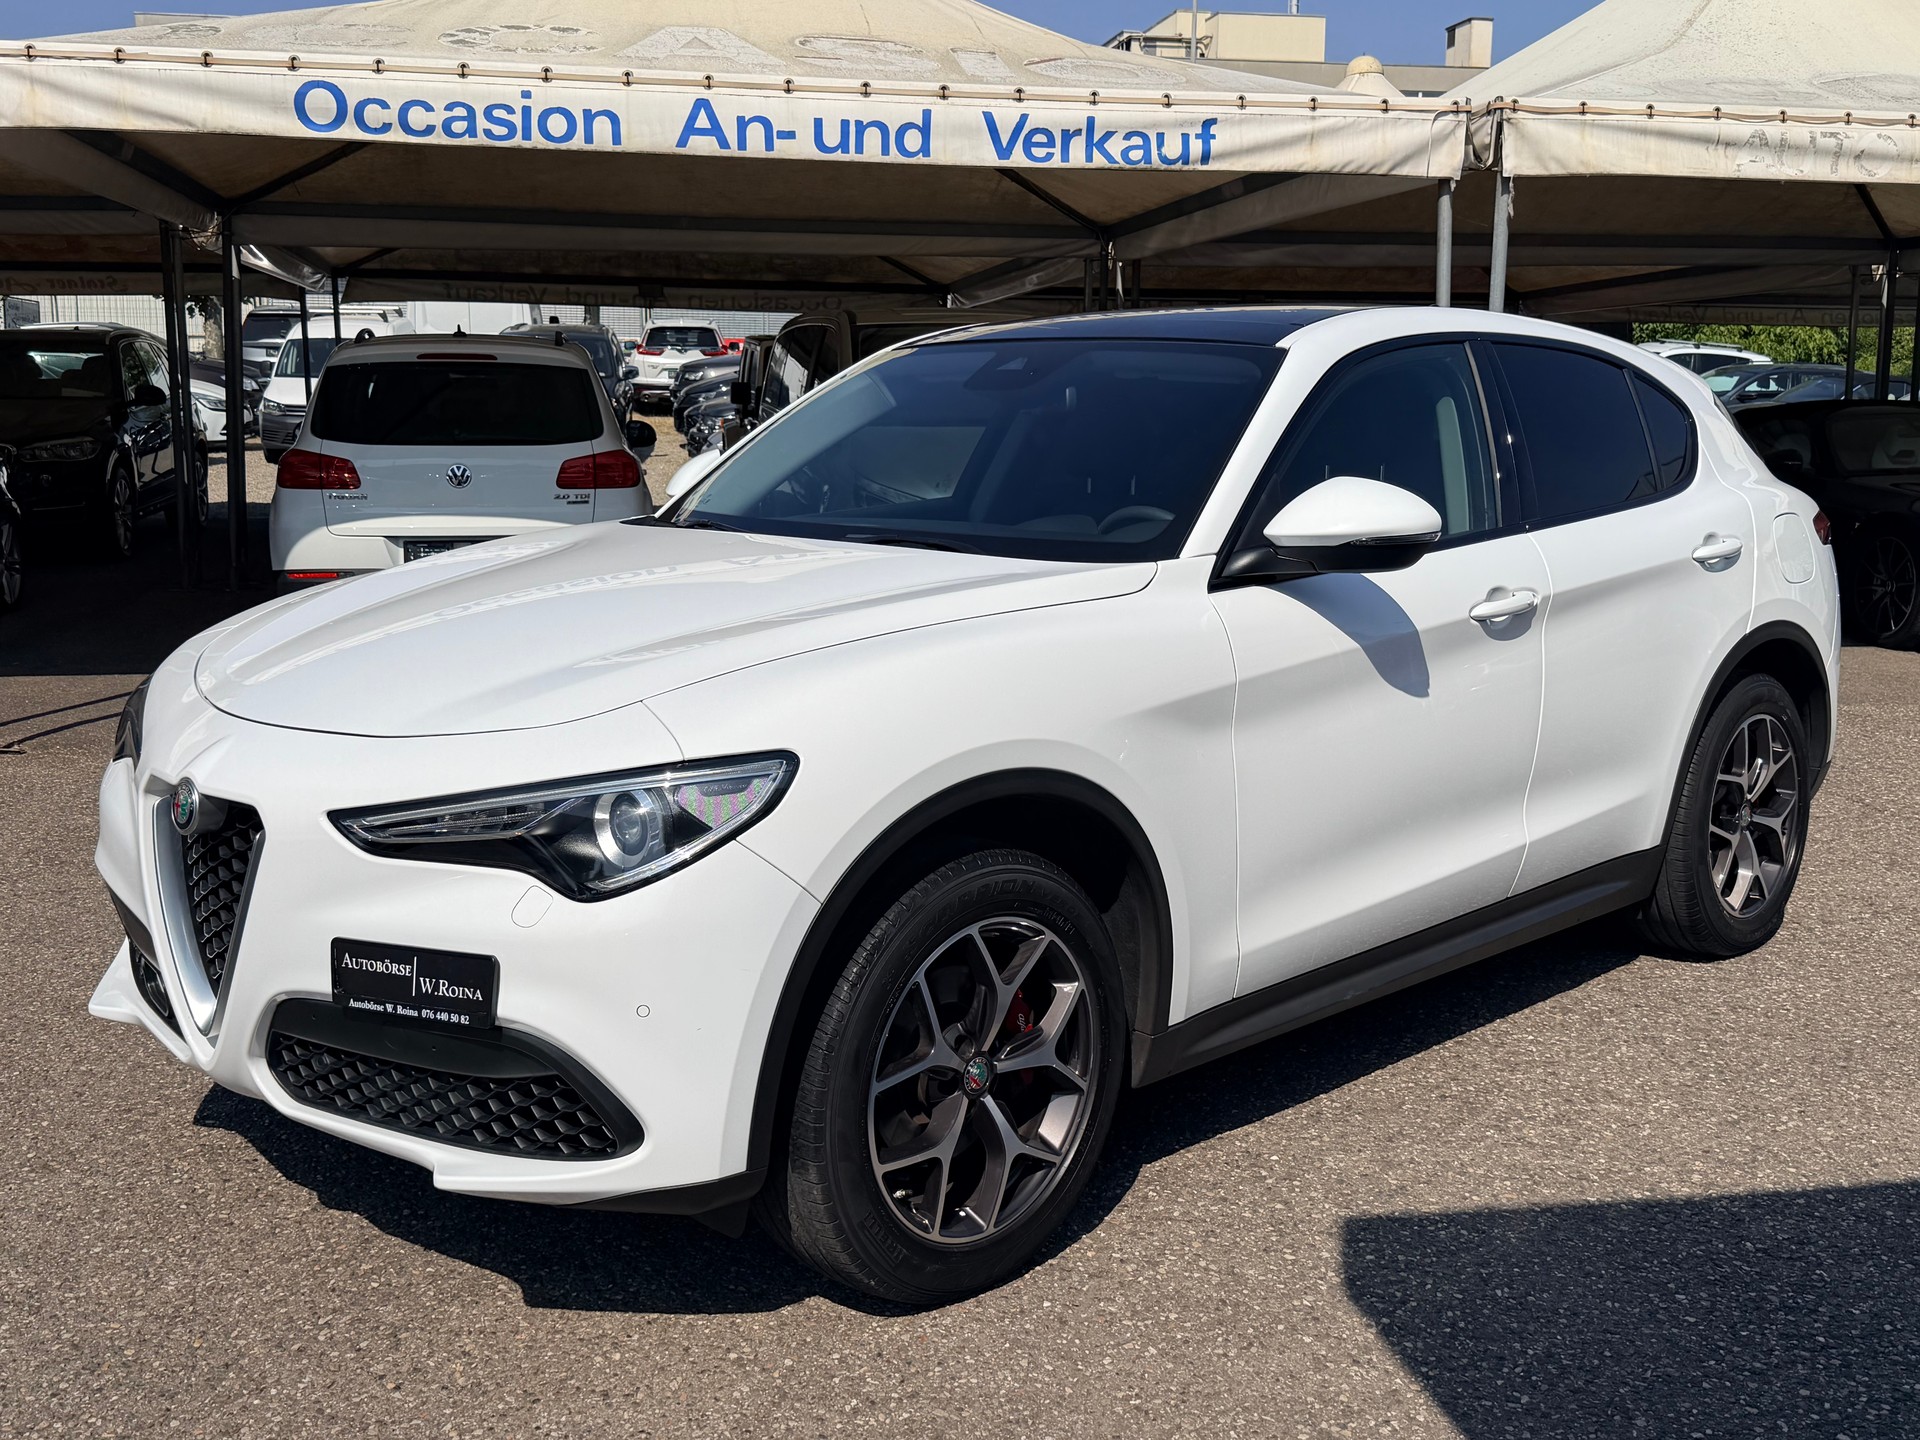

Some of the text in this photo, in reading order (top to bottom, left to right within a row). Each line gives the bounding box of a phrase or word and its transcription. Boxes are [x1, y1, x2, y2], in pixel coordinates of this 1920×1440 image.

[293, 80, 622, 146] Occasion
[982, 111, 1218, 167] Verkauf
[1733, 128, 1904, 178] AUTO
[341, 952, 412, 977] AUTOBÖRSE
[349, 998, 385, 1012] Autobörse
[397, 1004, 419, 1017] Roina
[421, 1009, 435, 1020] 076
[436, 1010, 449, 1021] 440
[450, 1012, 459, 1023] 50
[460, 1014, 470, 1025] 82
